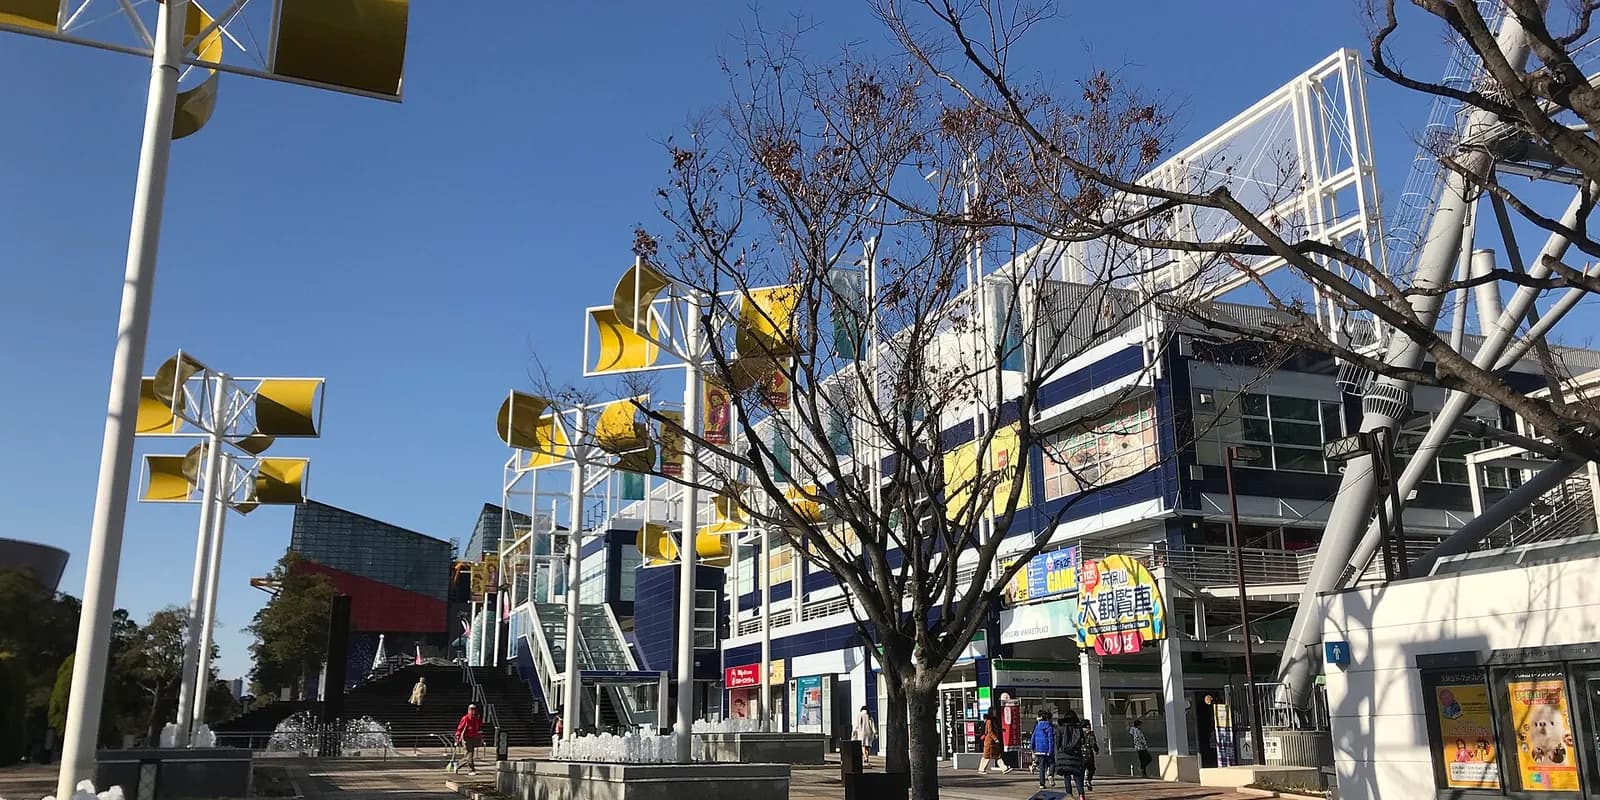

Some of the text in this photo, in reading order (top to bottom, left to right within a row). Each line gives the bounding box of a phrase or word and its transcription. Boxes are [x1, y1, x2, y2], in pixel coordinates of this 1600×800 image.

[1047, 567, 1076, 593] GAME
[1102, 571, 1127, 586] 天保山
[1081, 585, 1153, 623] 大観覧車
[1104, 634, 1133, 652] のりば
[945, 692, 953, 754] FamilyMart
